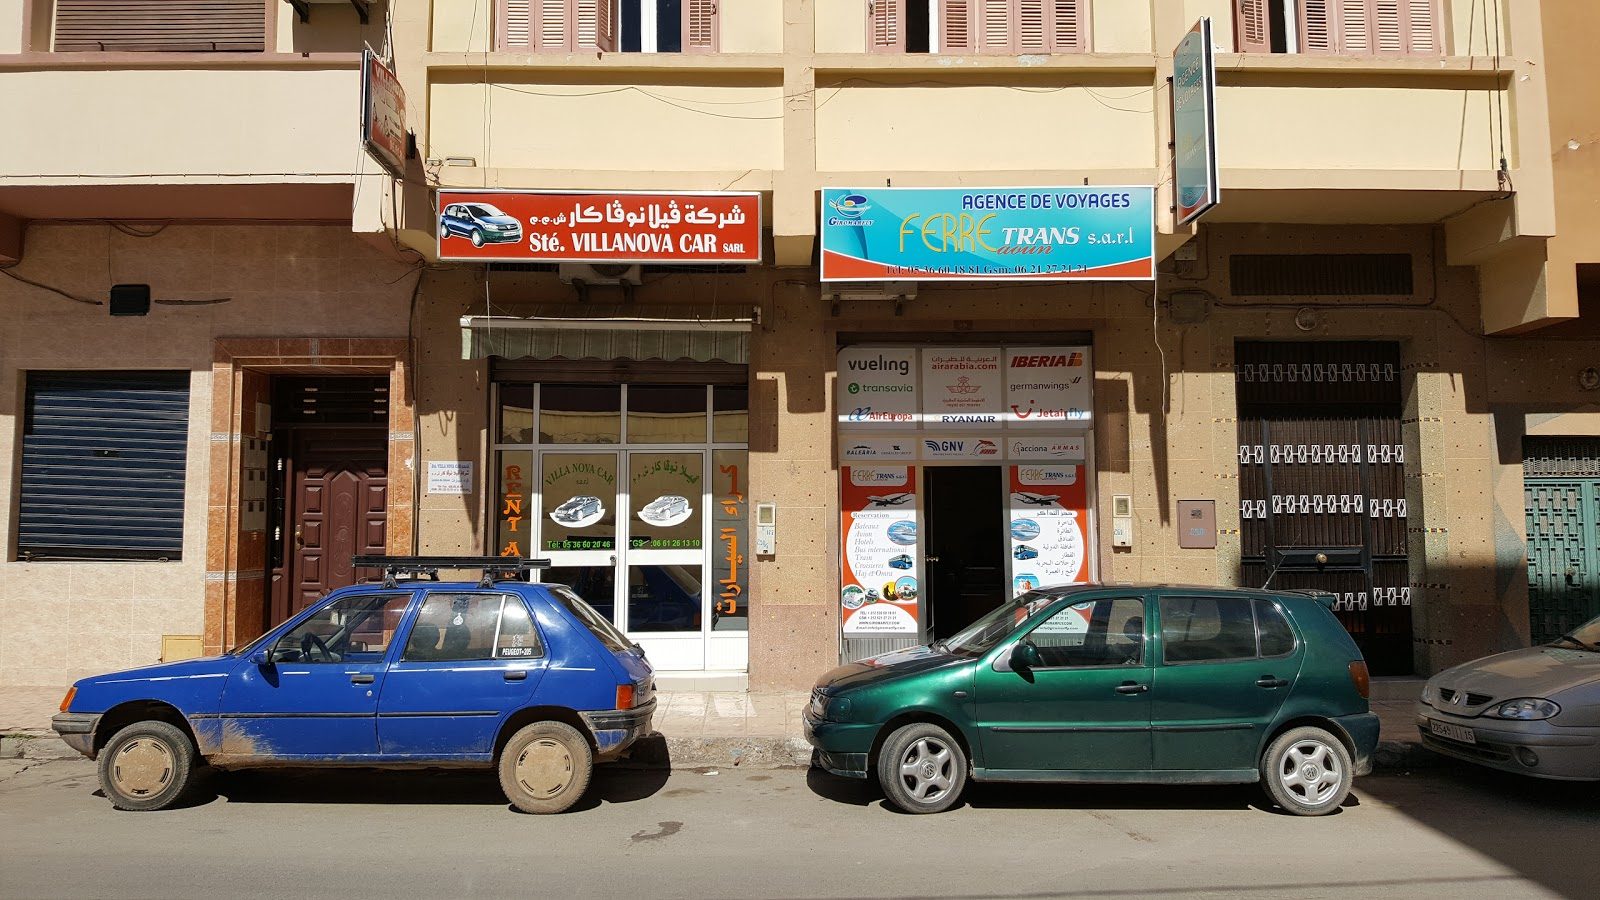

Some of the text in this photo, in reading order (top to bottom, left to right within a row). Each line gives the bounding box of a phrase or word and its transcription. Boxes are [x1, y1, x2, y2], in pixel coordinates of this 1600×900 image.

[962, 193, 1130, 209] AGENCE DE VOYAGES
[568, 203, 604, 228] كار
[685, 204, 745, 229] شركة
[900, 212, 1134, 253] FERRE TRANS s.a.r.l
[529, 232, 746, 253] Sté. VILLANOVA CAR SARL
[908, 265, 919, 274] 05
[924, 265, 935, 274] 36
[938, 266, 950, 274] 60
[954, 266, 965, 274] 18
[968, 266, 980, 274] 81
[982, 265, 1012, 274] Gsm:
[1014, 265, 1027, 274] 06
[848, 355, 909, 375] vueling
[931, 362, 997, 370] airarabia.com
[1011, 356, 1066, 368] IBERIA
[862, 384, 913, 392] transavia
[1010, 382, 1070, 391] germanwings
[1037, 408, 1084, 418] Jetairfly
[942, 415, 996, 423] RYANAIR
[941, 441, 964, 452] GNV
[545, 463, 614, 486] VILLA NOVA CAR
[562, 540, 571, 549] 05
[572, 540, 581, 548] 36
[582, 540, 591, 548] 60
[592, 540, 601, 548] 20
[662, 540, 671, 548] 61
[681, 540, 690, 548] 13
[692, 540, 700, 548] 10
[716, 526, 743, 614] السيارات
[1464, 730, 1474, 741] 15
